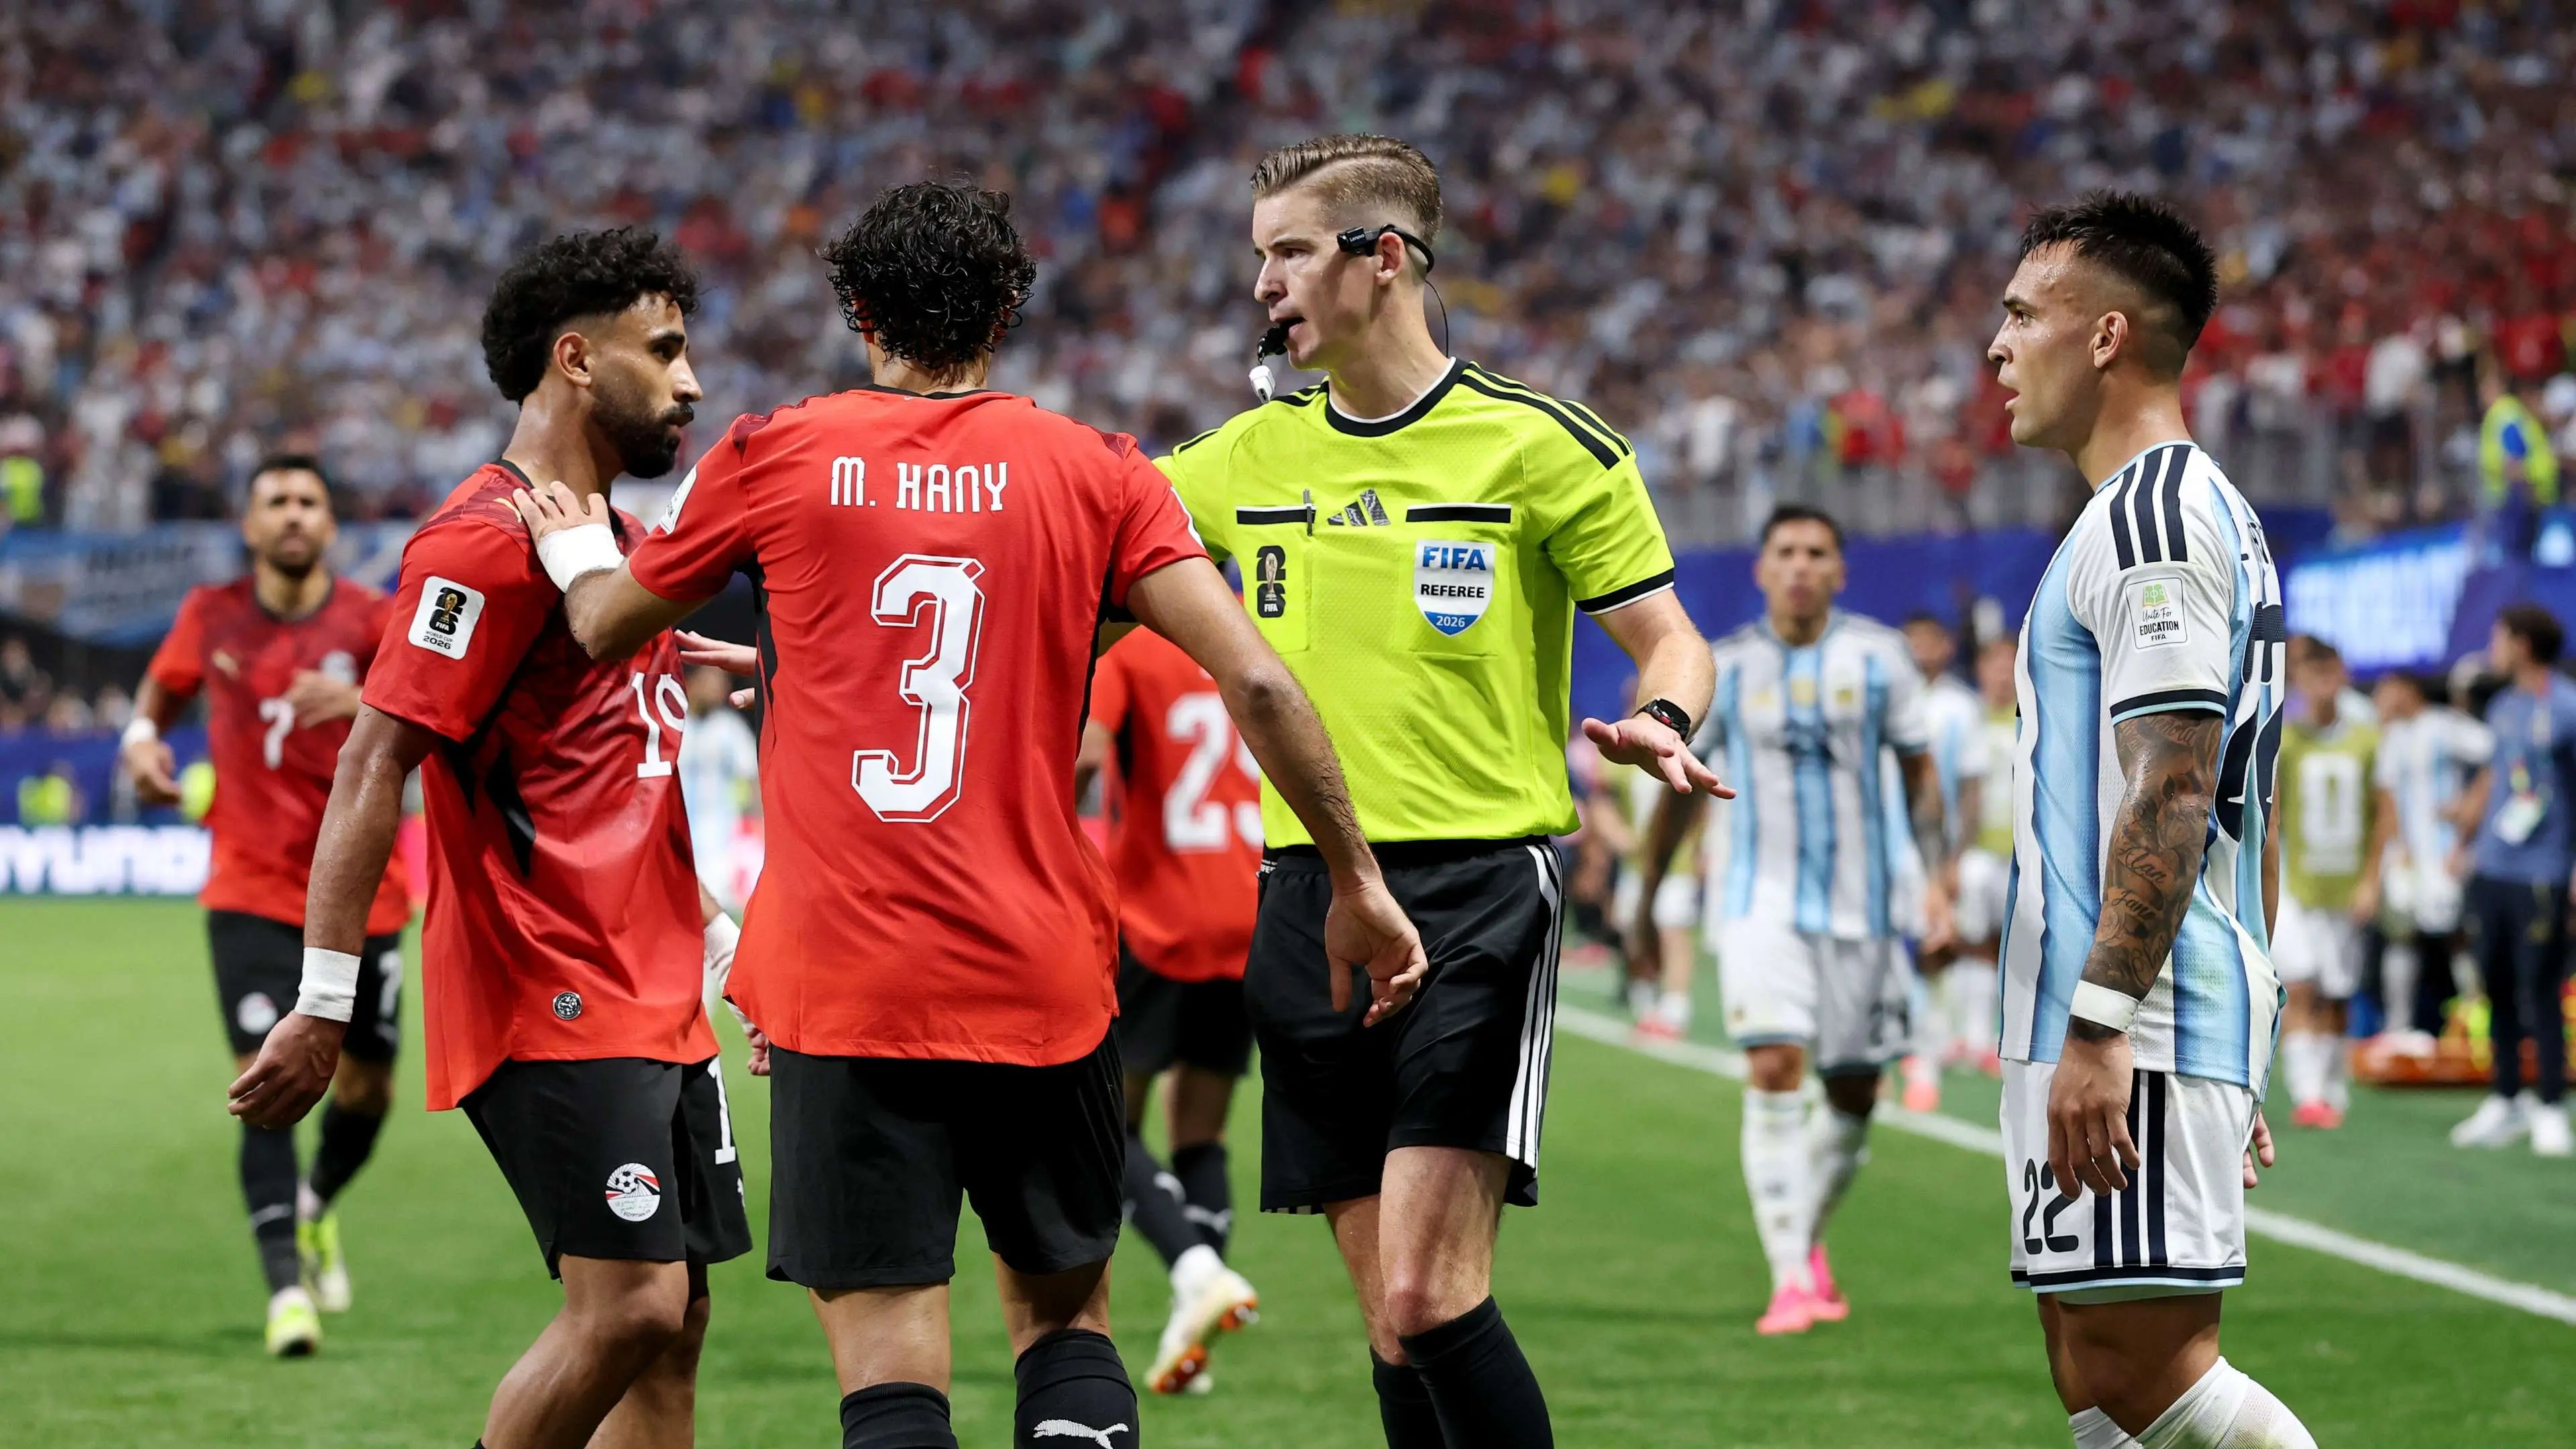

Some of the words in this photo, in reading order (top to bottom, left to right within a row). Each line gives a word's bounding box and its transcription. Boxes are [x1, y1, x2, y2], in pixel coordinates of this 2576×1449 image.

[1349, 233, 1365, 242] Lenovo
[830, 456, 876, 506] M.
[896, 462, 1008, 513] HANY
[1422, 545, 1487, 571] FIFA
[1420, 584, 1485, 598] REFEREE
[1264, 603, 1279, 612] FIFA
[2143, 609, 2160, 622] Unite
[2160, 606, 2171, 619] For
[435, 621, 449, 631] FIFA
[1436, 615, 1466, 628] 2026
[2139, 621, 2179, 635] EDUCATION
[423, 635, 451, 649] 2026
[425, 630, 444, 640] WORLD
[851, 553, 985, 823] 3
[258, 698, 295, 770] 7
[2023, 1159, 2082, 1254] 22
